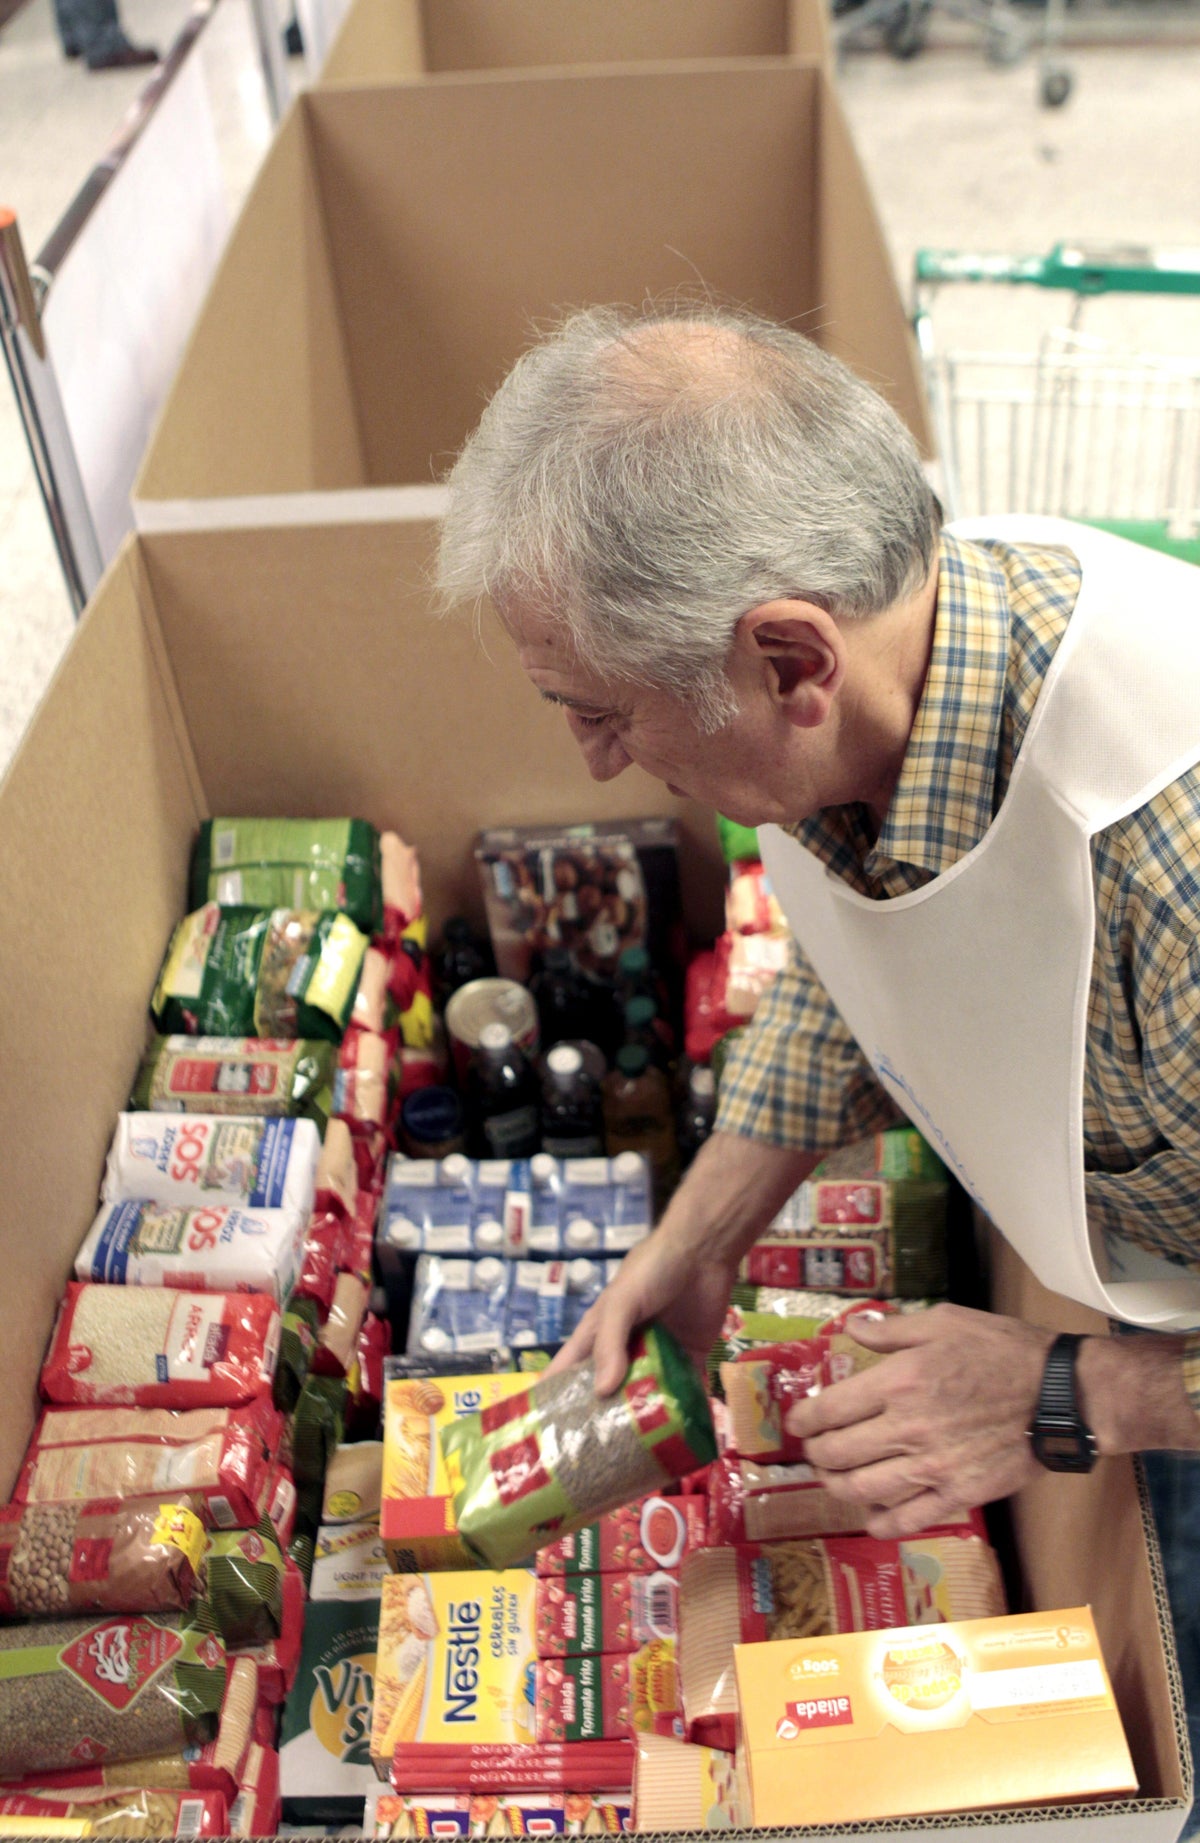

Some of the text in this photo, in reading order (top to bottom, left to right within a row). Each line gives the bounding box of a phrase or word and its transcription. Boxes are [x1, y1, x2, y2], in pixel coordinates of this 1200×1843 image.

[172, 1123, 208, 1183] SOS
[579, 1528, 593, 1571] Tomate
[491, 1586, 507, 1658] cereales
[507, 1593, 521, 1656] sin gluten
[561, 1600, 575, 1637] aliada
[580, 1577, 594, 1651] Tomate frito
[560, 1682, 575, 1722] aliada
[580, 1659, 595, 1738] Tomate frito
[796, 1698, 850, 1719] aliada
